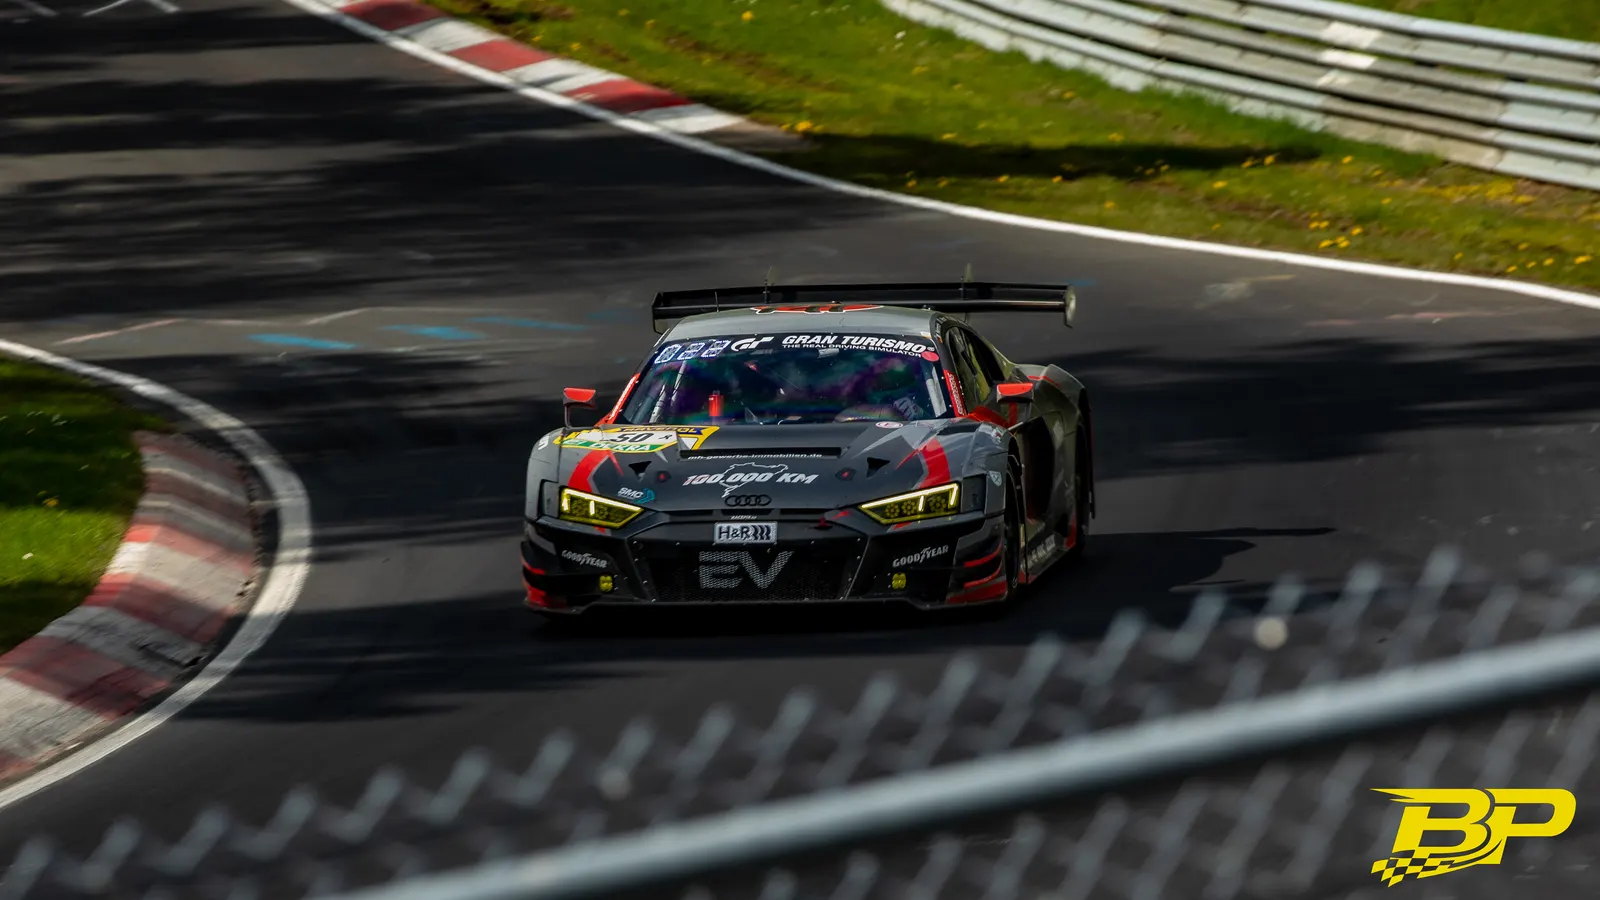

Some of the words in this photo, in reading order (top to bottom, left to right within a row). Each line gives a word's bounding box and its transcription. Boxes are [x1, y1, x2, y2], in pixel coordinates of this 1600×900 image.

[782, 335, 838, 345] GRAN
[868, 346, 922, 358] SIMULATOR
[610, 432, 655, 443] 50
[776, 472, 819, 485] KM
[719, 525, 751, 540] H&R
[561, 549, 608, 568] GOODYEAR
[891, 544, 949, 568] GOODYEAR
[699, 551, 795, 589] EV
